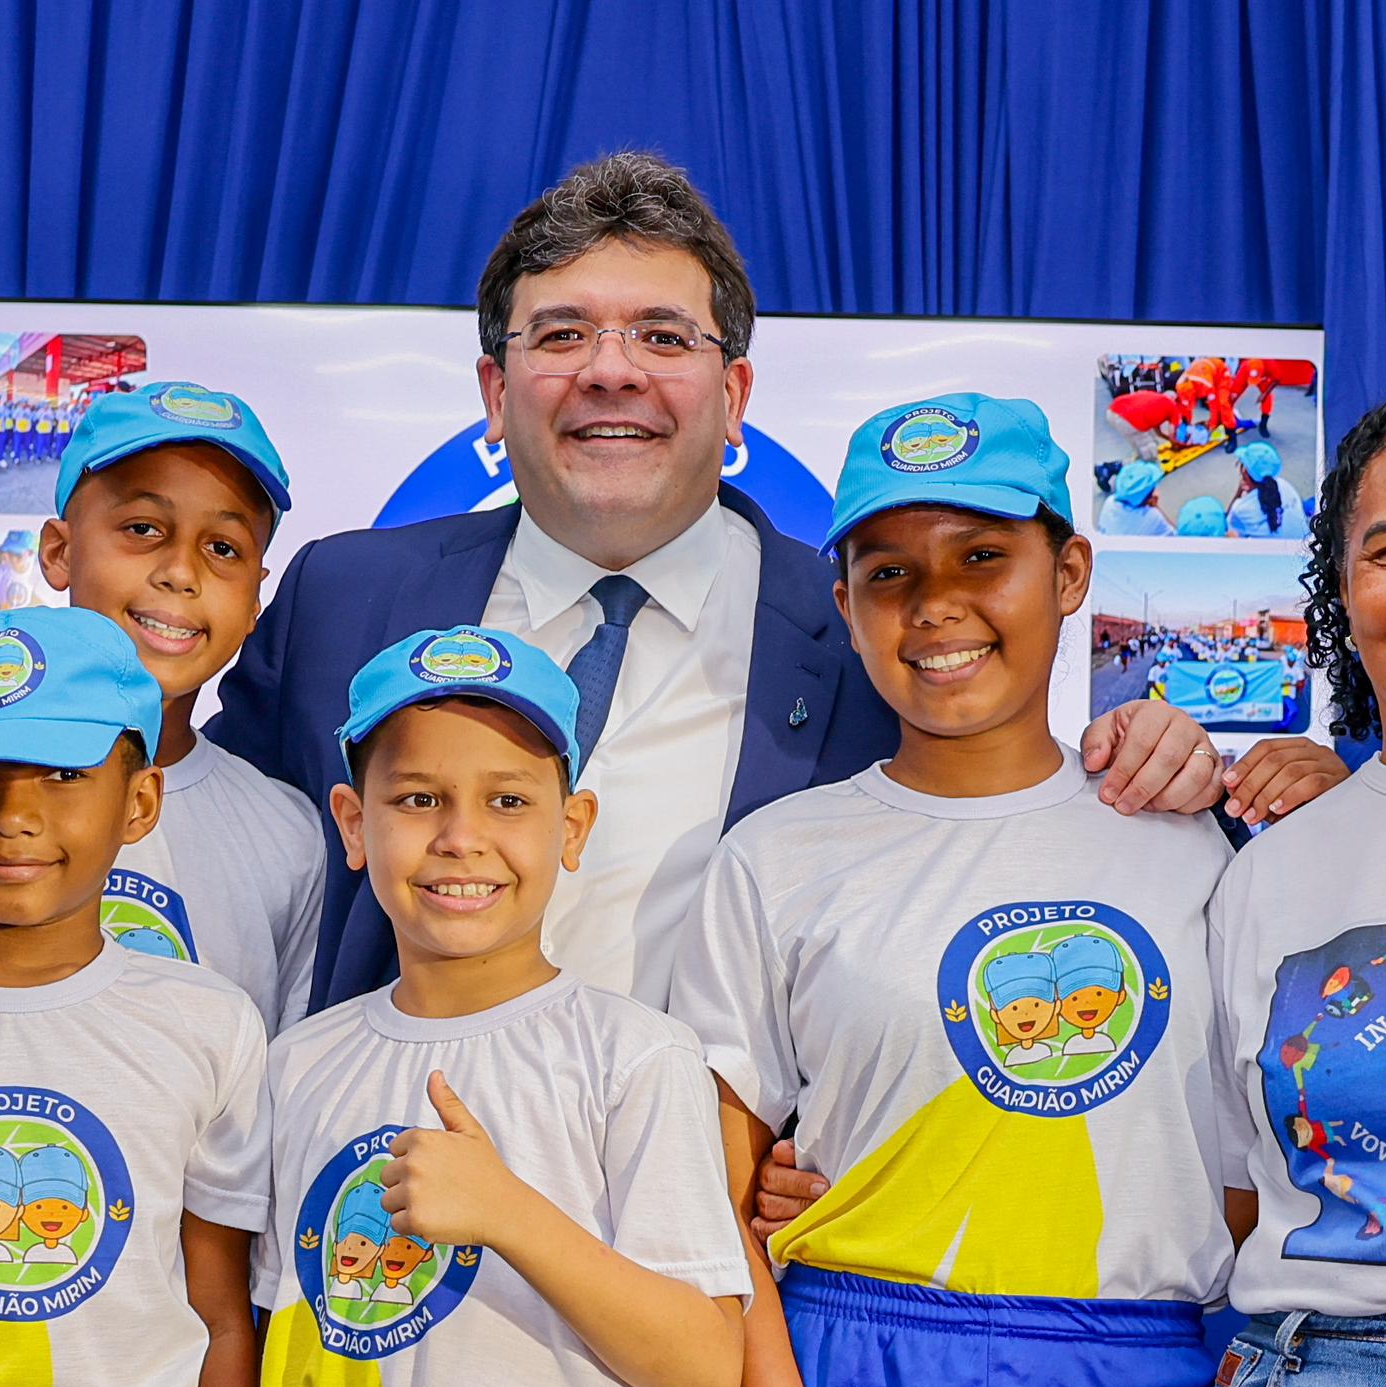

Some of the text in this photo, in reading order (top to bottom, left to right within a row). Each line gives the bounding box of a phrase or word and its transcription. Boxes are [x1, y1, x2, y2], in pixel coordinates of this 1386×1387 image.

[904, 408, 955, 421] PROJETO
[940, 450, 968, 469] MIRIM
[1, 685, 32, 706] MIRIM
[977, 905, 1096, 936] PROJETO
[977, 1049, 1141, 1112] GUARDIÃO MIRIM
[43, 1265, 102, 1313] MIRIM
[375, 1305, 434, 1353] MIRIM
